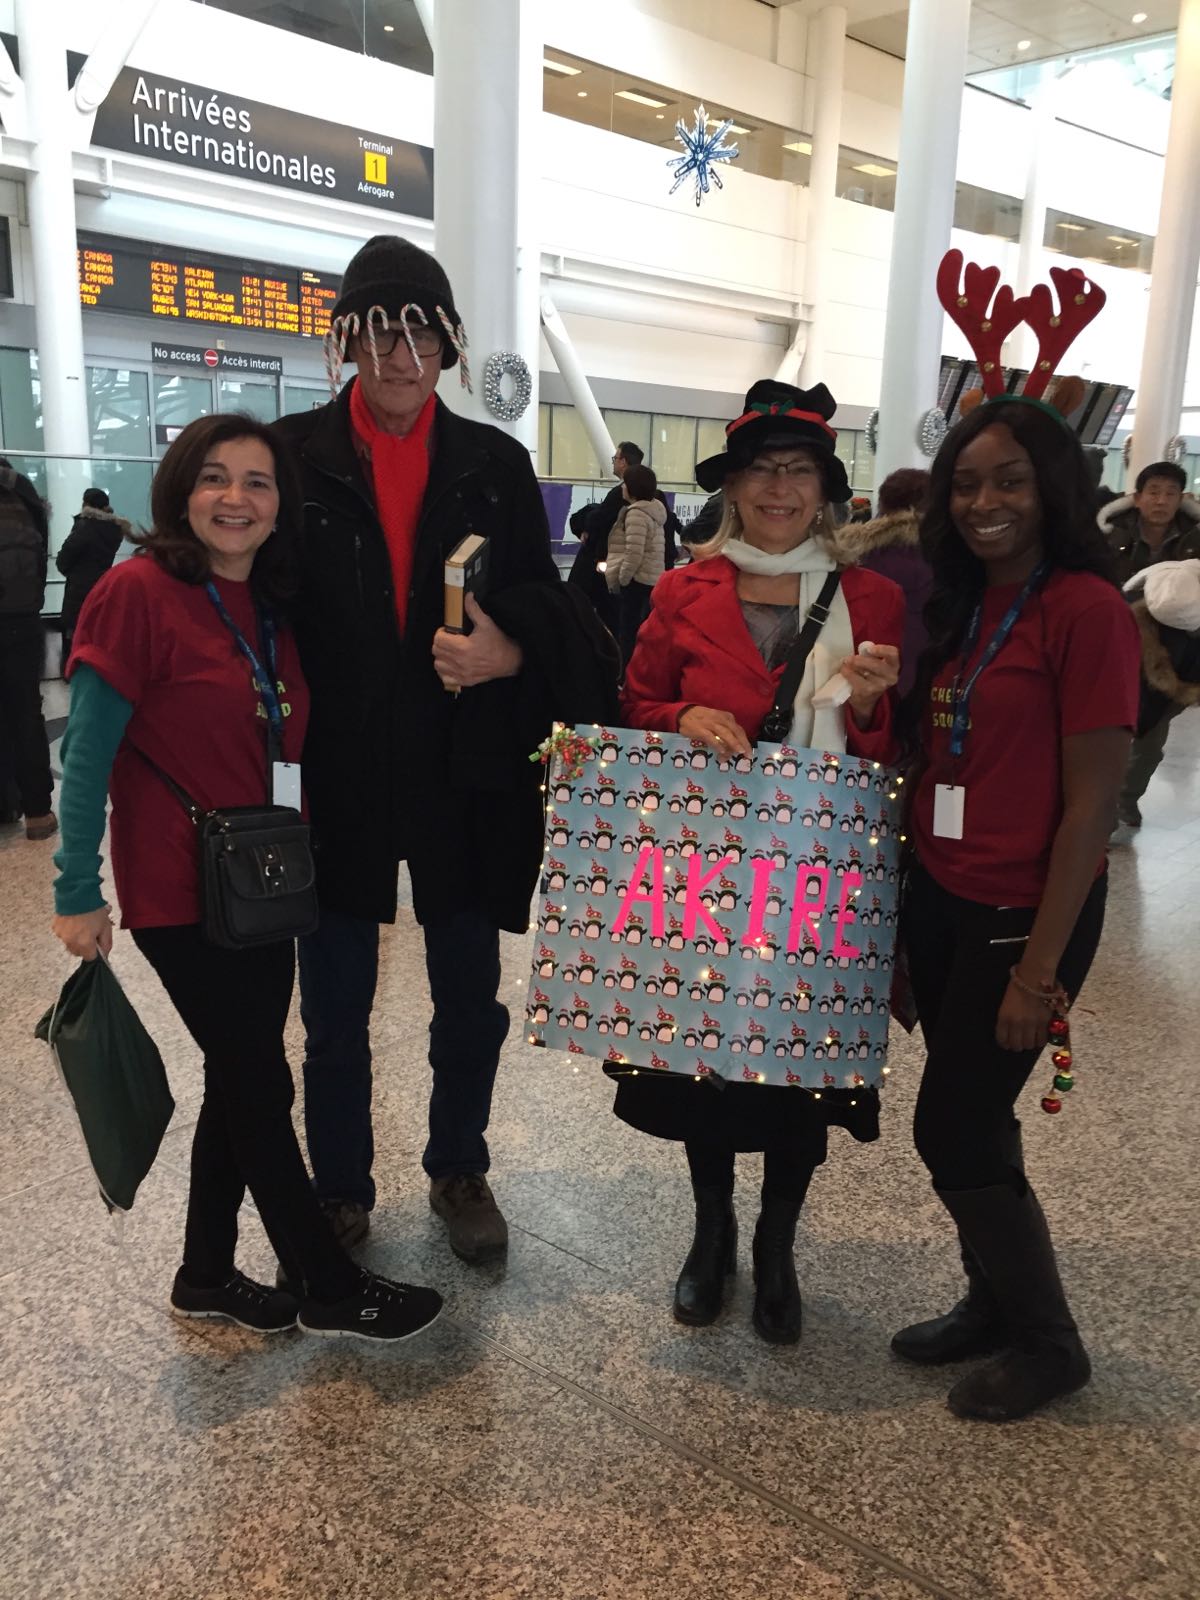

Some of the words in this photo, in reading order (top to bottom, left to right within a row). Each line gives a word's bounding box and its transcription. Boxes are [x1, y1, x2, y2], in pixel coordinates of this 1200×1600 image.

[132, 77, 251, 133] Arrivées
[133, 114, 336, 188] Internationales
[358, 137, 393, 156] Terminal
[373, 158, 379, 179] 1
[357, 181, 395, 199] Aérogare
[84, 250, 112, 263] CANADA
[184, 267, 214, 279] RALEIGH
[84, 262, 113, 274] CANADA
[185, 277, 214, 289] ATLANTA
[85, 273, 113, 285] CANADA
[185, 288, 199, 298] NEW
[314, 288, 336, 298] CANADA
[154, 347, 167, 358] No
[170, 350, 201, 362] access
[222, 356, 248, 367] Accès
[250, 358, 280, 371] interdit
[676, 505, 690, 518] MGA
[612, 846, 864, 958] AKIRE
